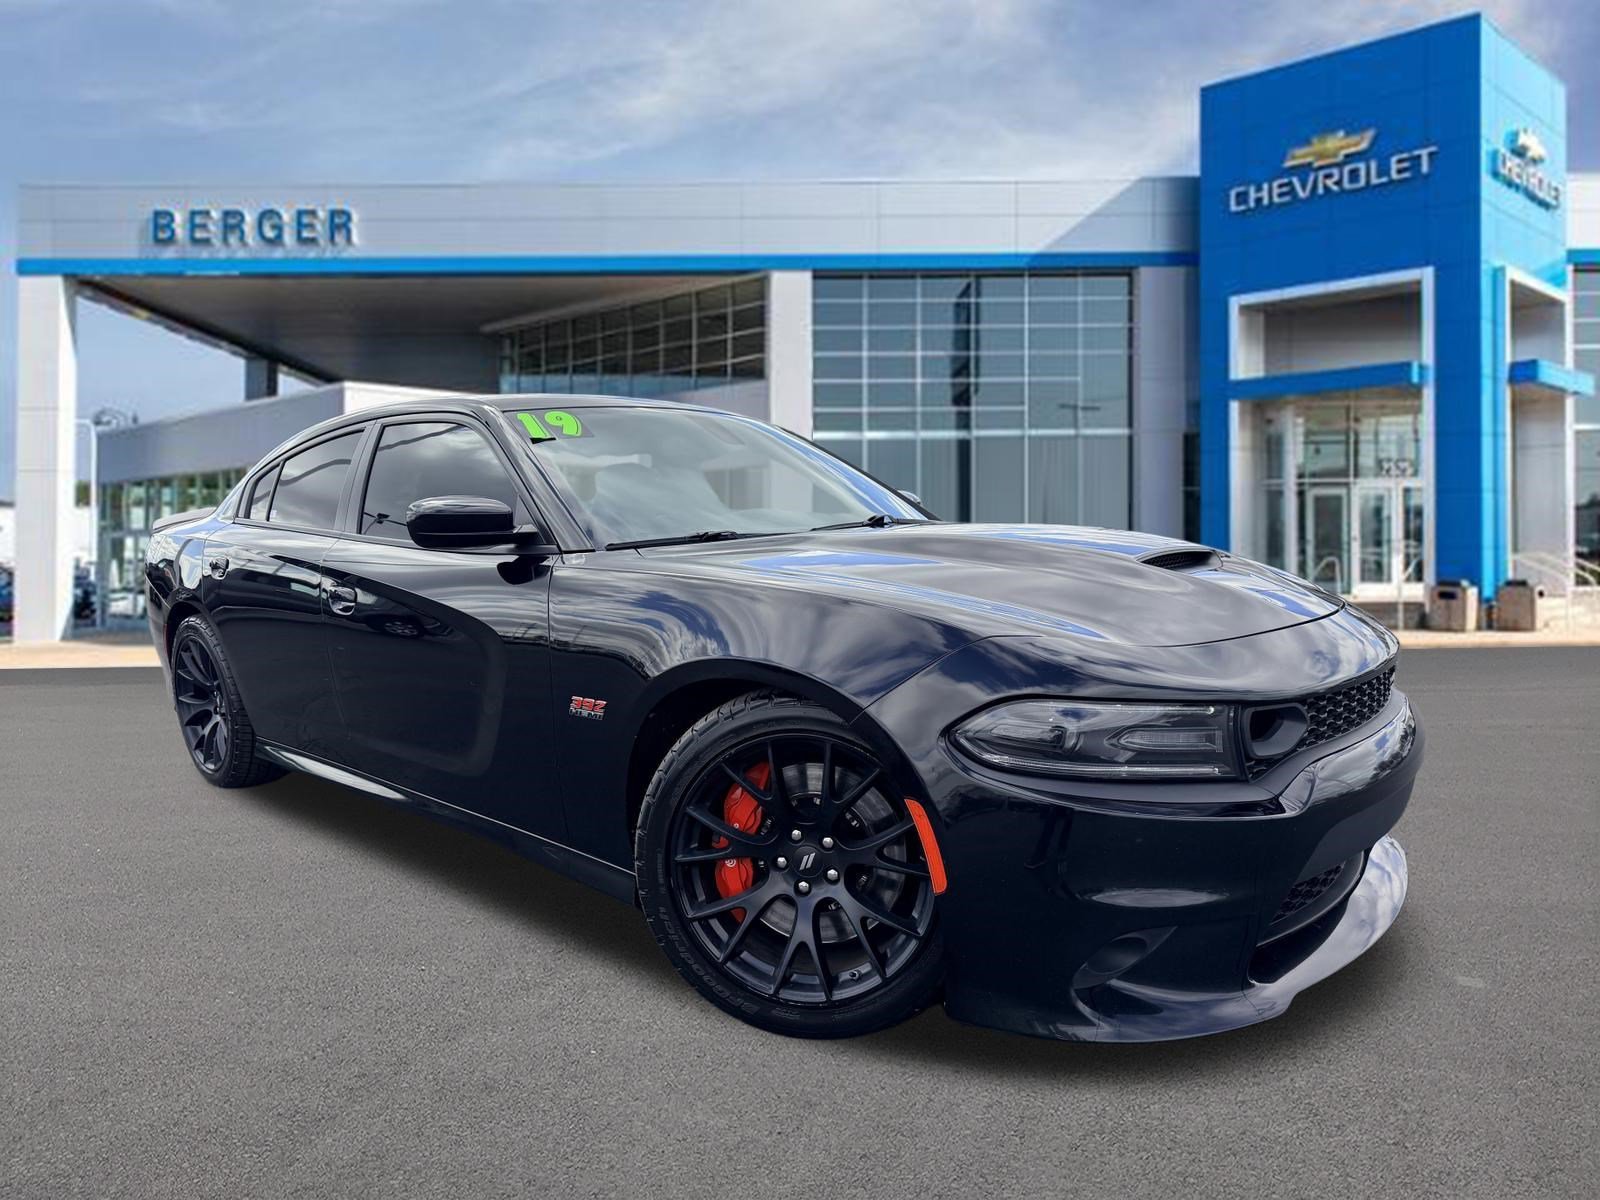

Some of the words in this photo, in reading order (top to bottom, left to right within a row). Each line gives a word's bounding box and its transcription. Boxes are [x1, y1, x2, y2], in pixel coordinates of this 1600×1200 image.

[1229, 146, 1439, 213] CHEVROLET
[152, 208, 355, 247] BERGER
[516, 410, 583, 438] 19
[569, 695, 608, 713] 392
